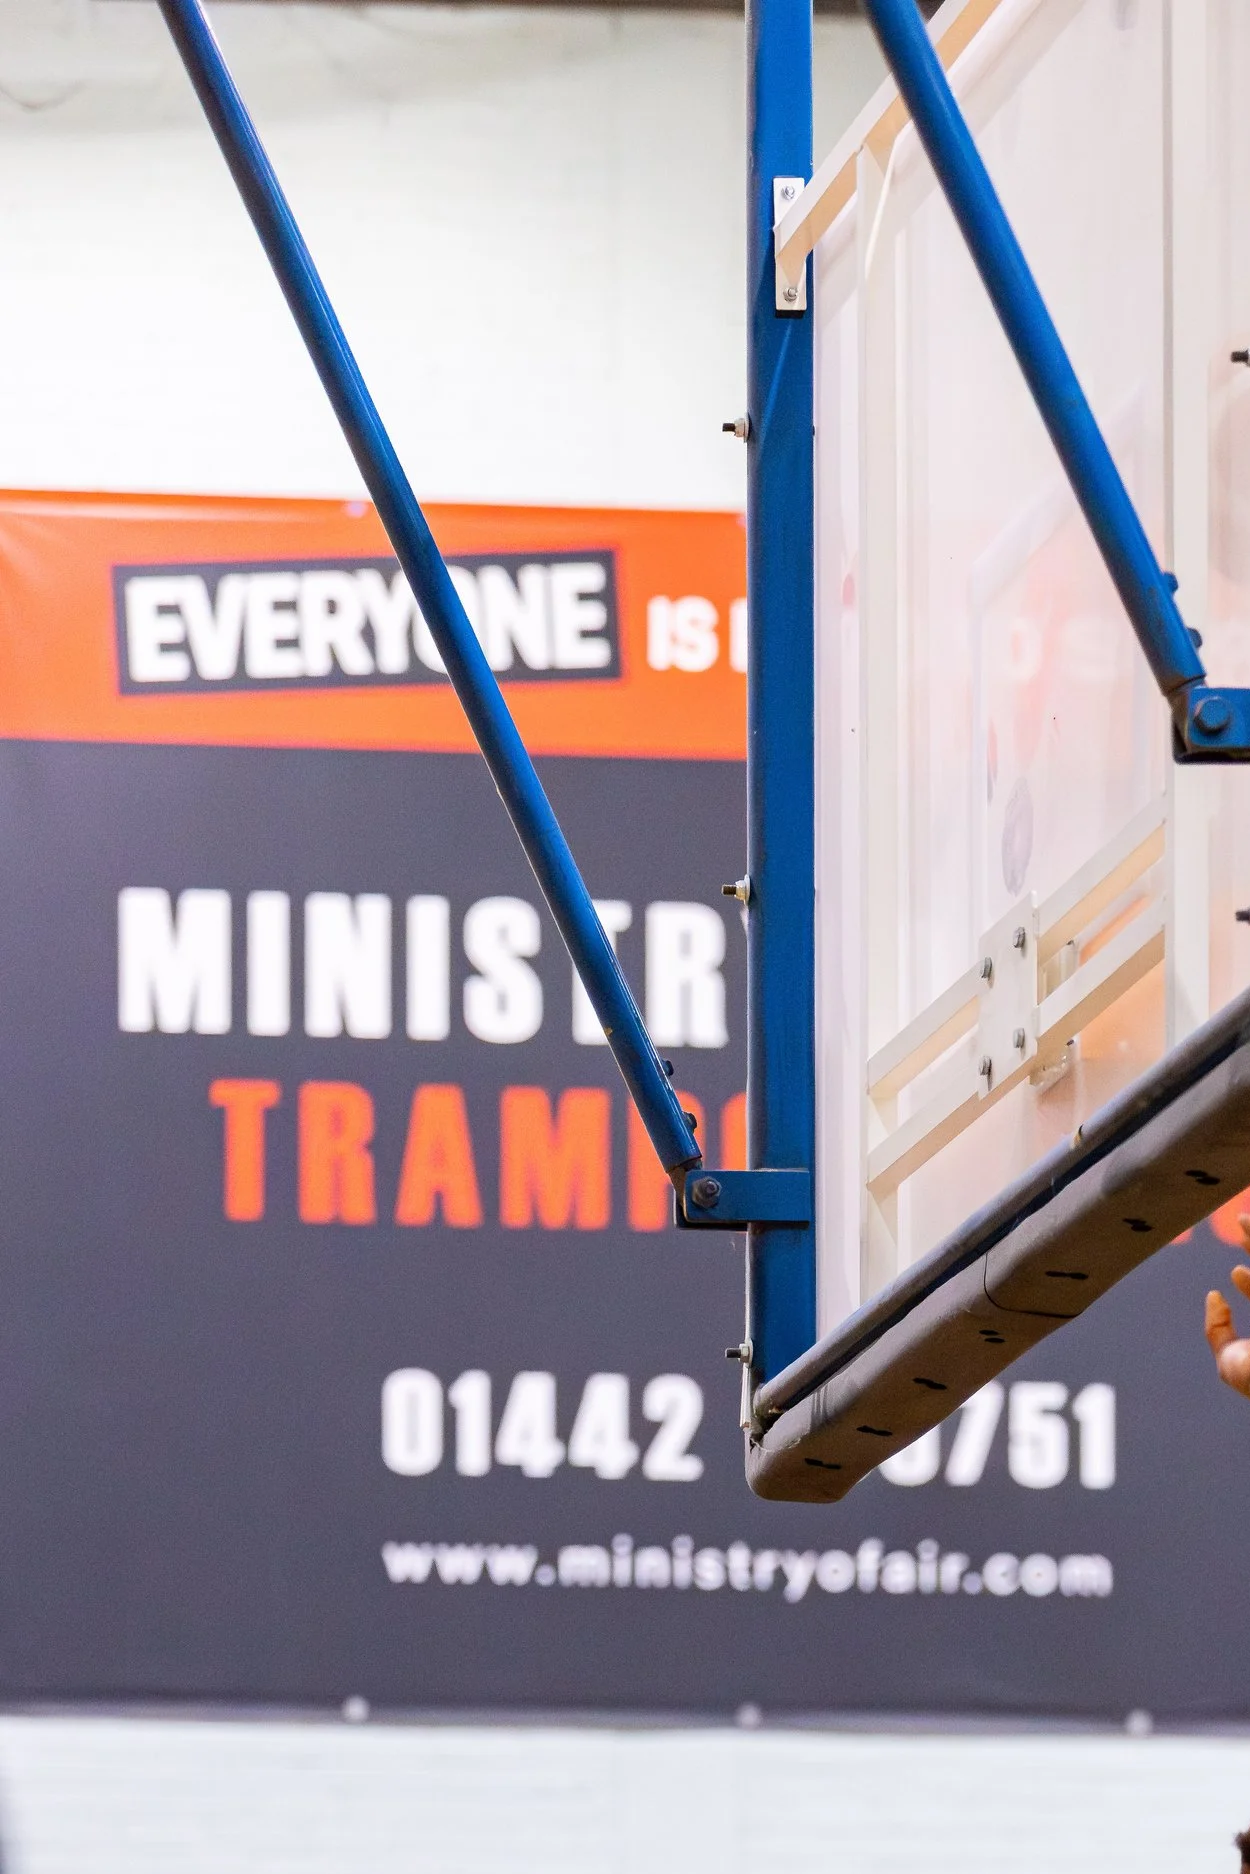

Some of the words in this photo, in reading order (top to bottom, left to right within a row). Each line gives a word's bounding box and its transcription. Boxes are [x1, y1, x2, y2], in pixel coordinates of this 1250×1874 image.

[124, 562, 612, 683] EVERYONE
[646, 594, 720, 673] IS
[117, 886, 748, 1050] MINISTR
[381, 1366, 704, 1482] 01442
[381, 1534, 1114, 1602] www.ministryofair.com
